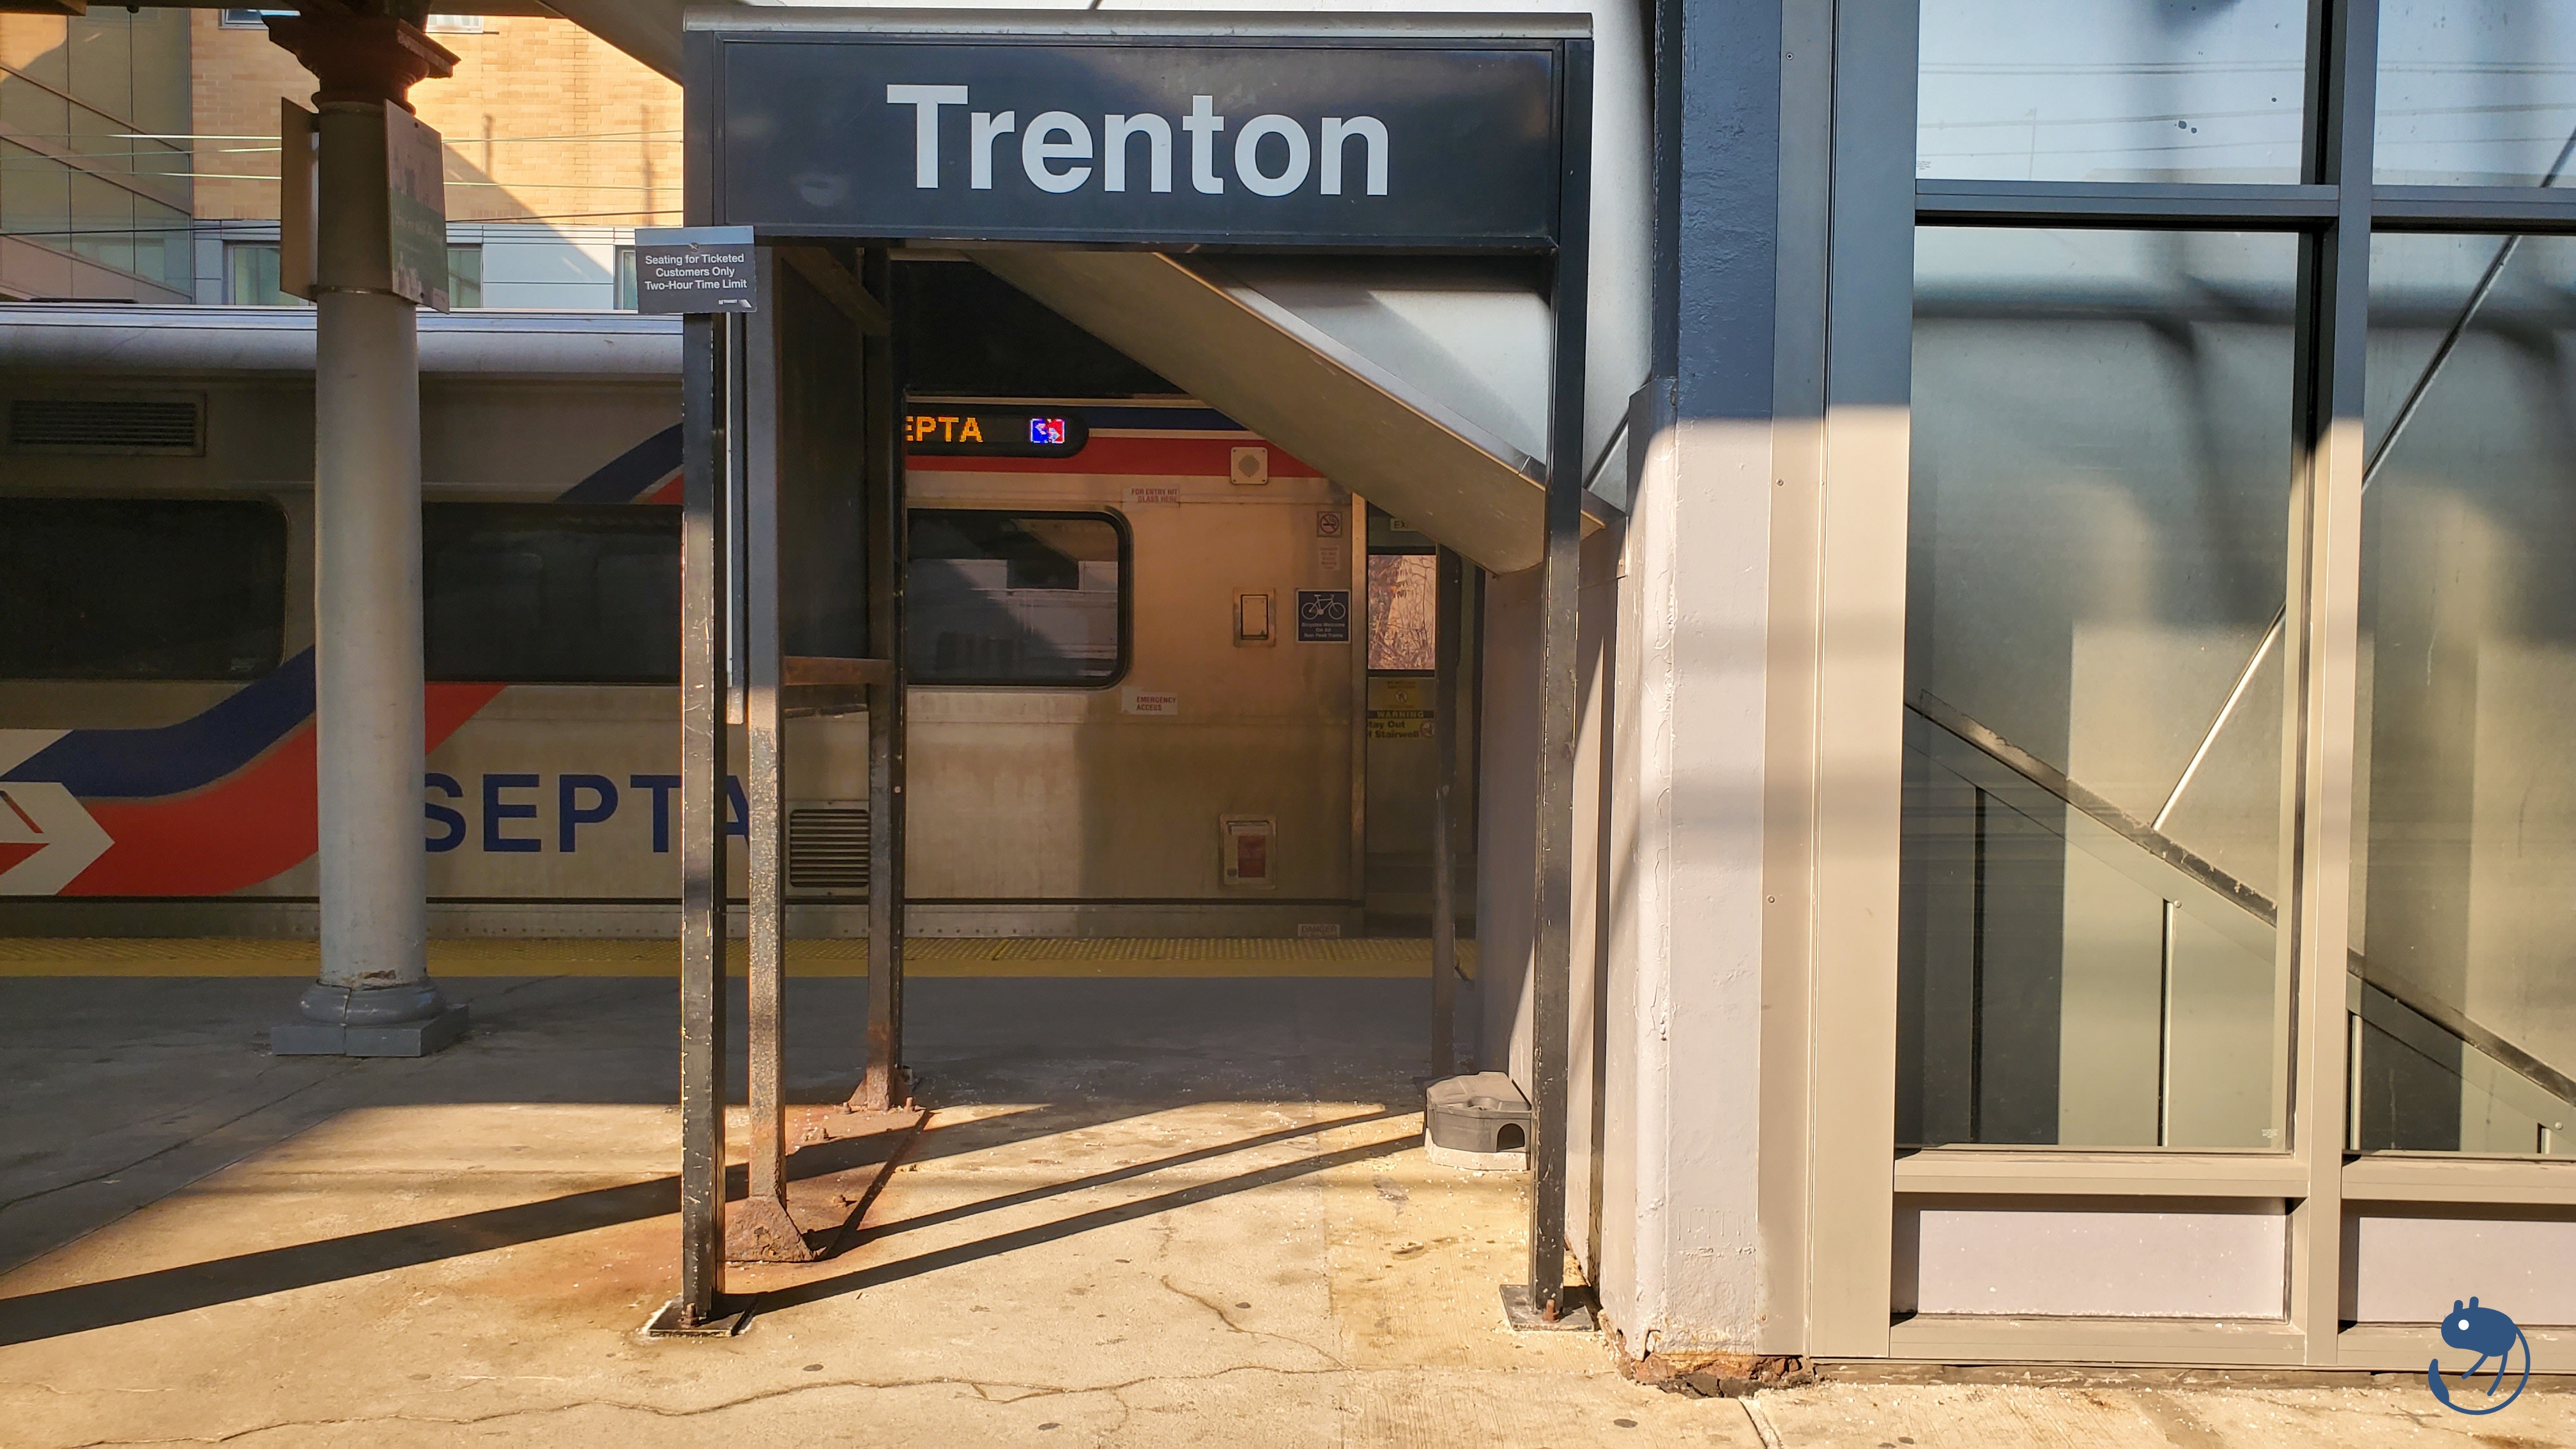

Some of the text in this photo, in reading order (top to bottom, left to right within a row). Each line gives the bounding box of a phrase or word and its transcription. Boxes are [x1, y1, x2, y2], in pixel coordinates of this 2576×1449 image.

[886, 84, 1390, 197] Trenton
[645, 253, 744, 266] Seating for Ticketed
[656, 266, 735, 278] Customers Only
[644, 279, 747, 291] Two-Hour Time Limit
[1367, 720, 1406, 730] tay Out
[1375, 730, 1419, 739] Stairwell
